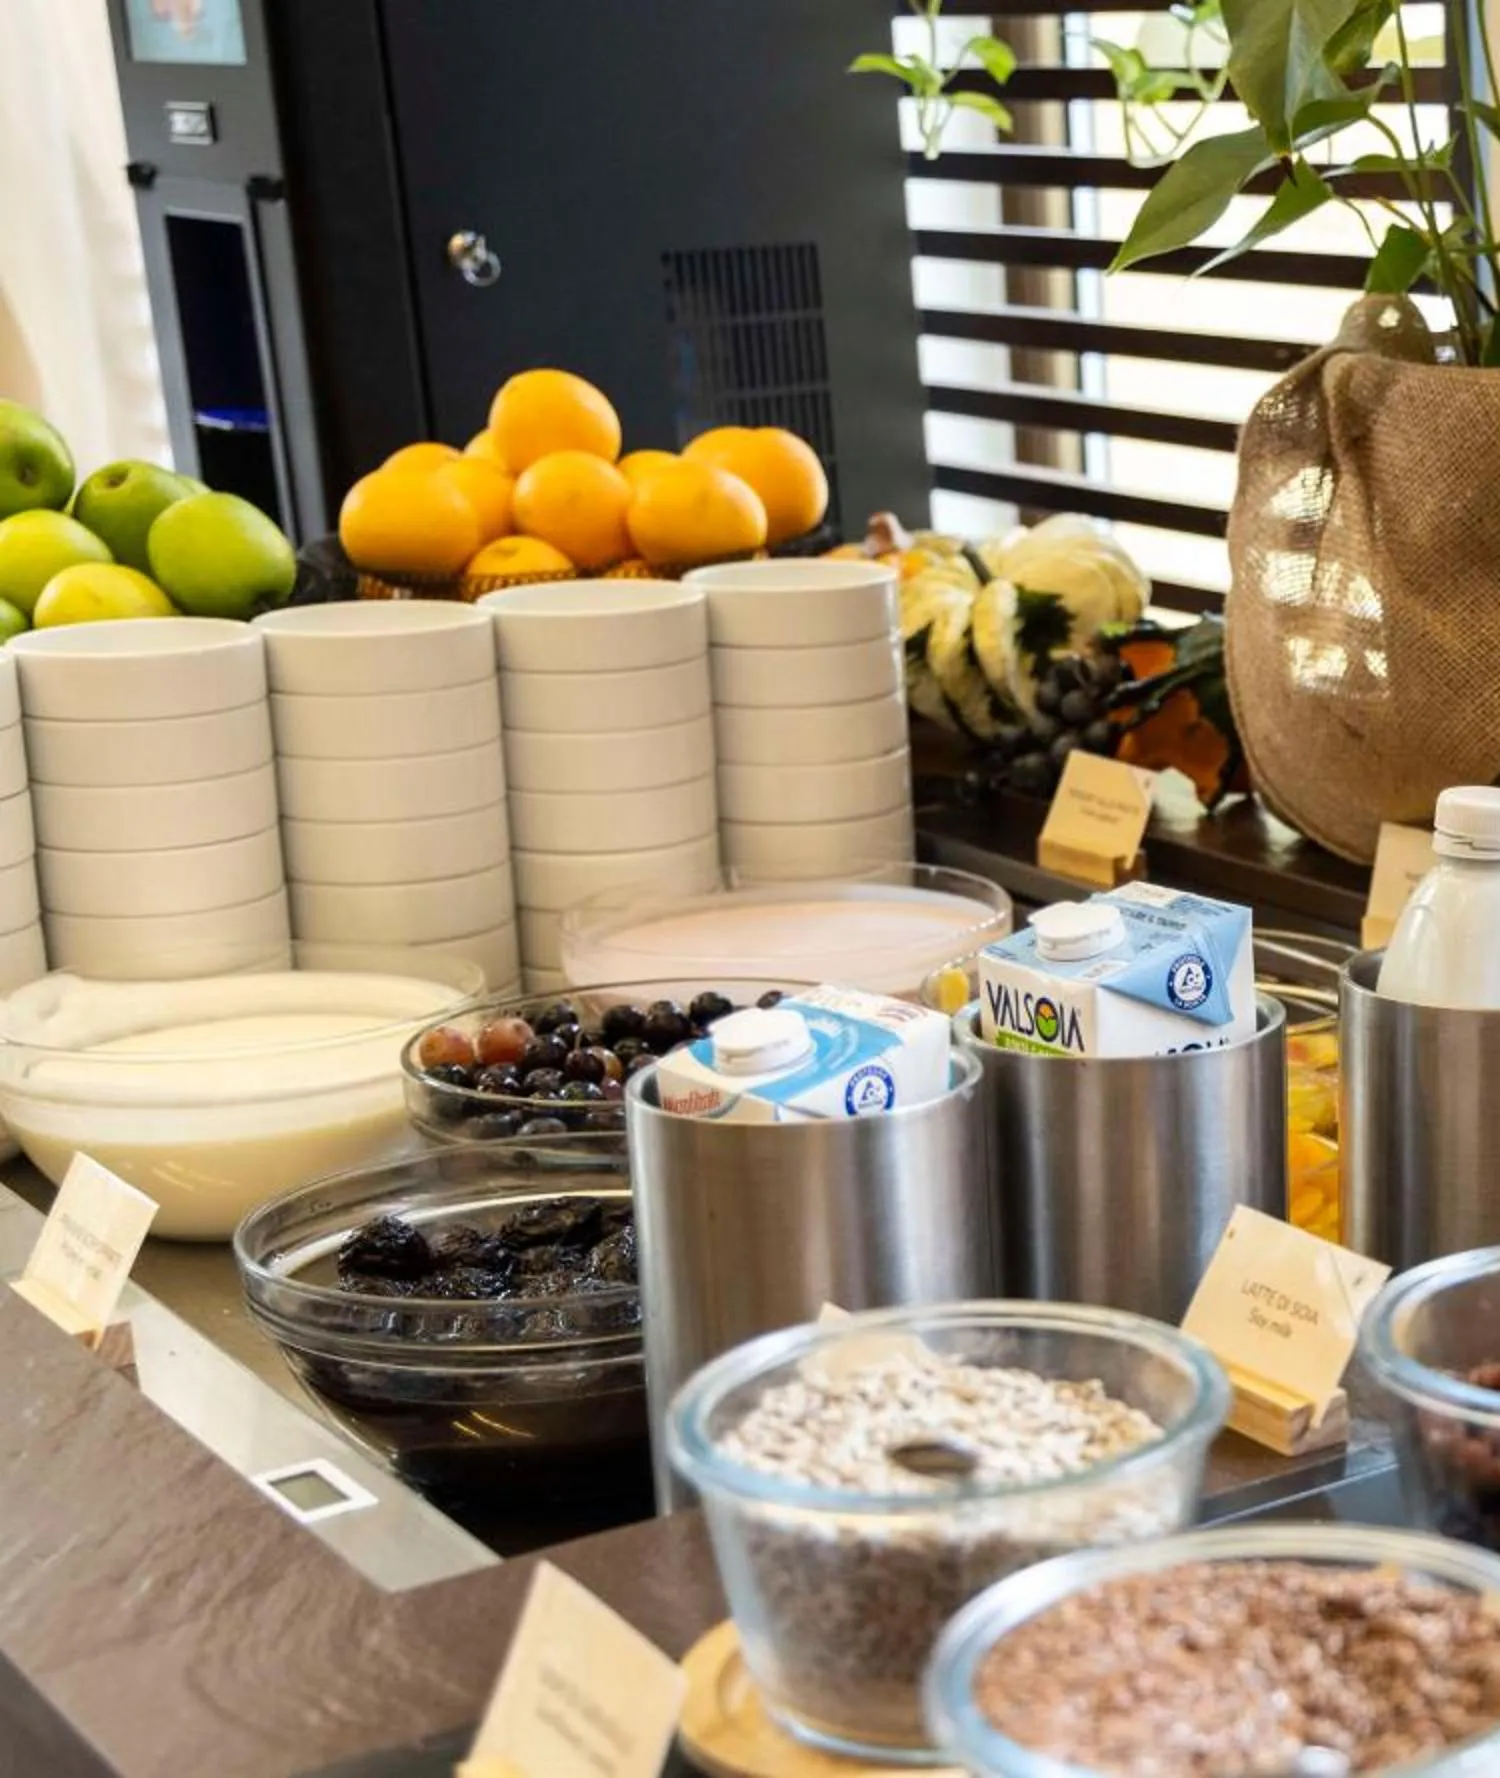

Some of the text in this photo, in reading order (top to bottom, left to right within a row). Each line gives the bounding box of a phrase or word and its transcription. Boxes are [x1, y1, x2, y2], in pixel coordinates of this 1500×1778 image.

[985, 980, 1084, 1052] VALSOIA
[1241, 1280, 1277, 1308] LATTE
[1290, 1302, 1320, 1326] SOIA
[1248, 1307, 1268, 1329] Soy
